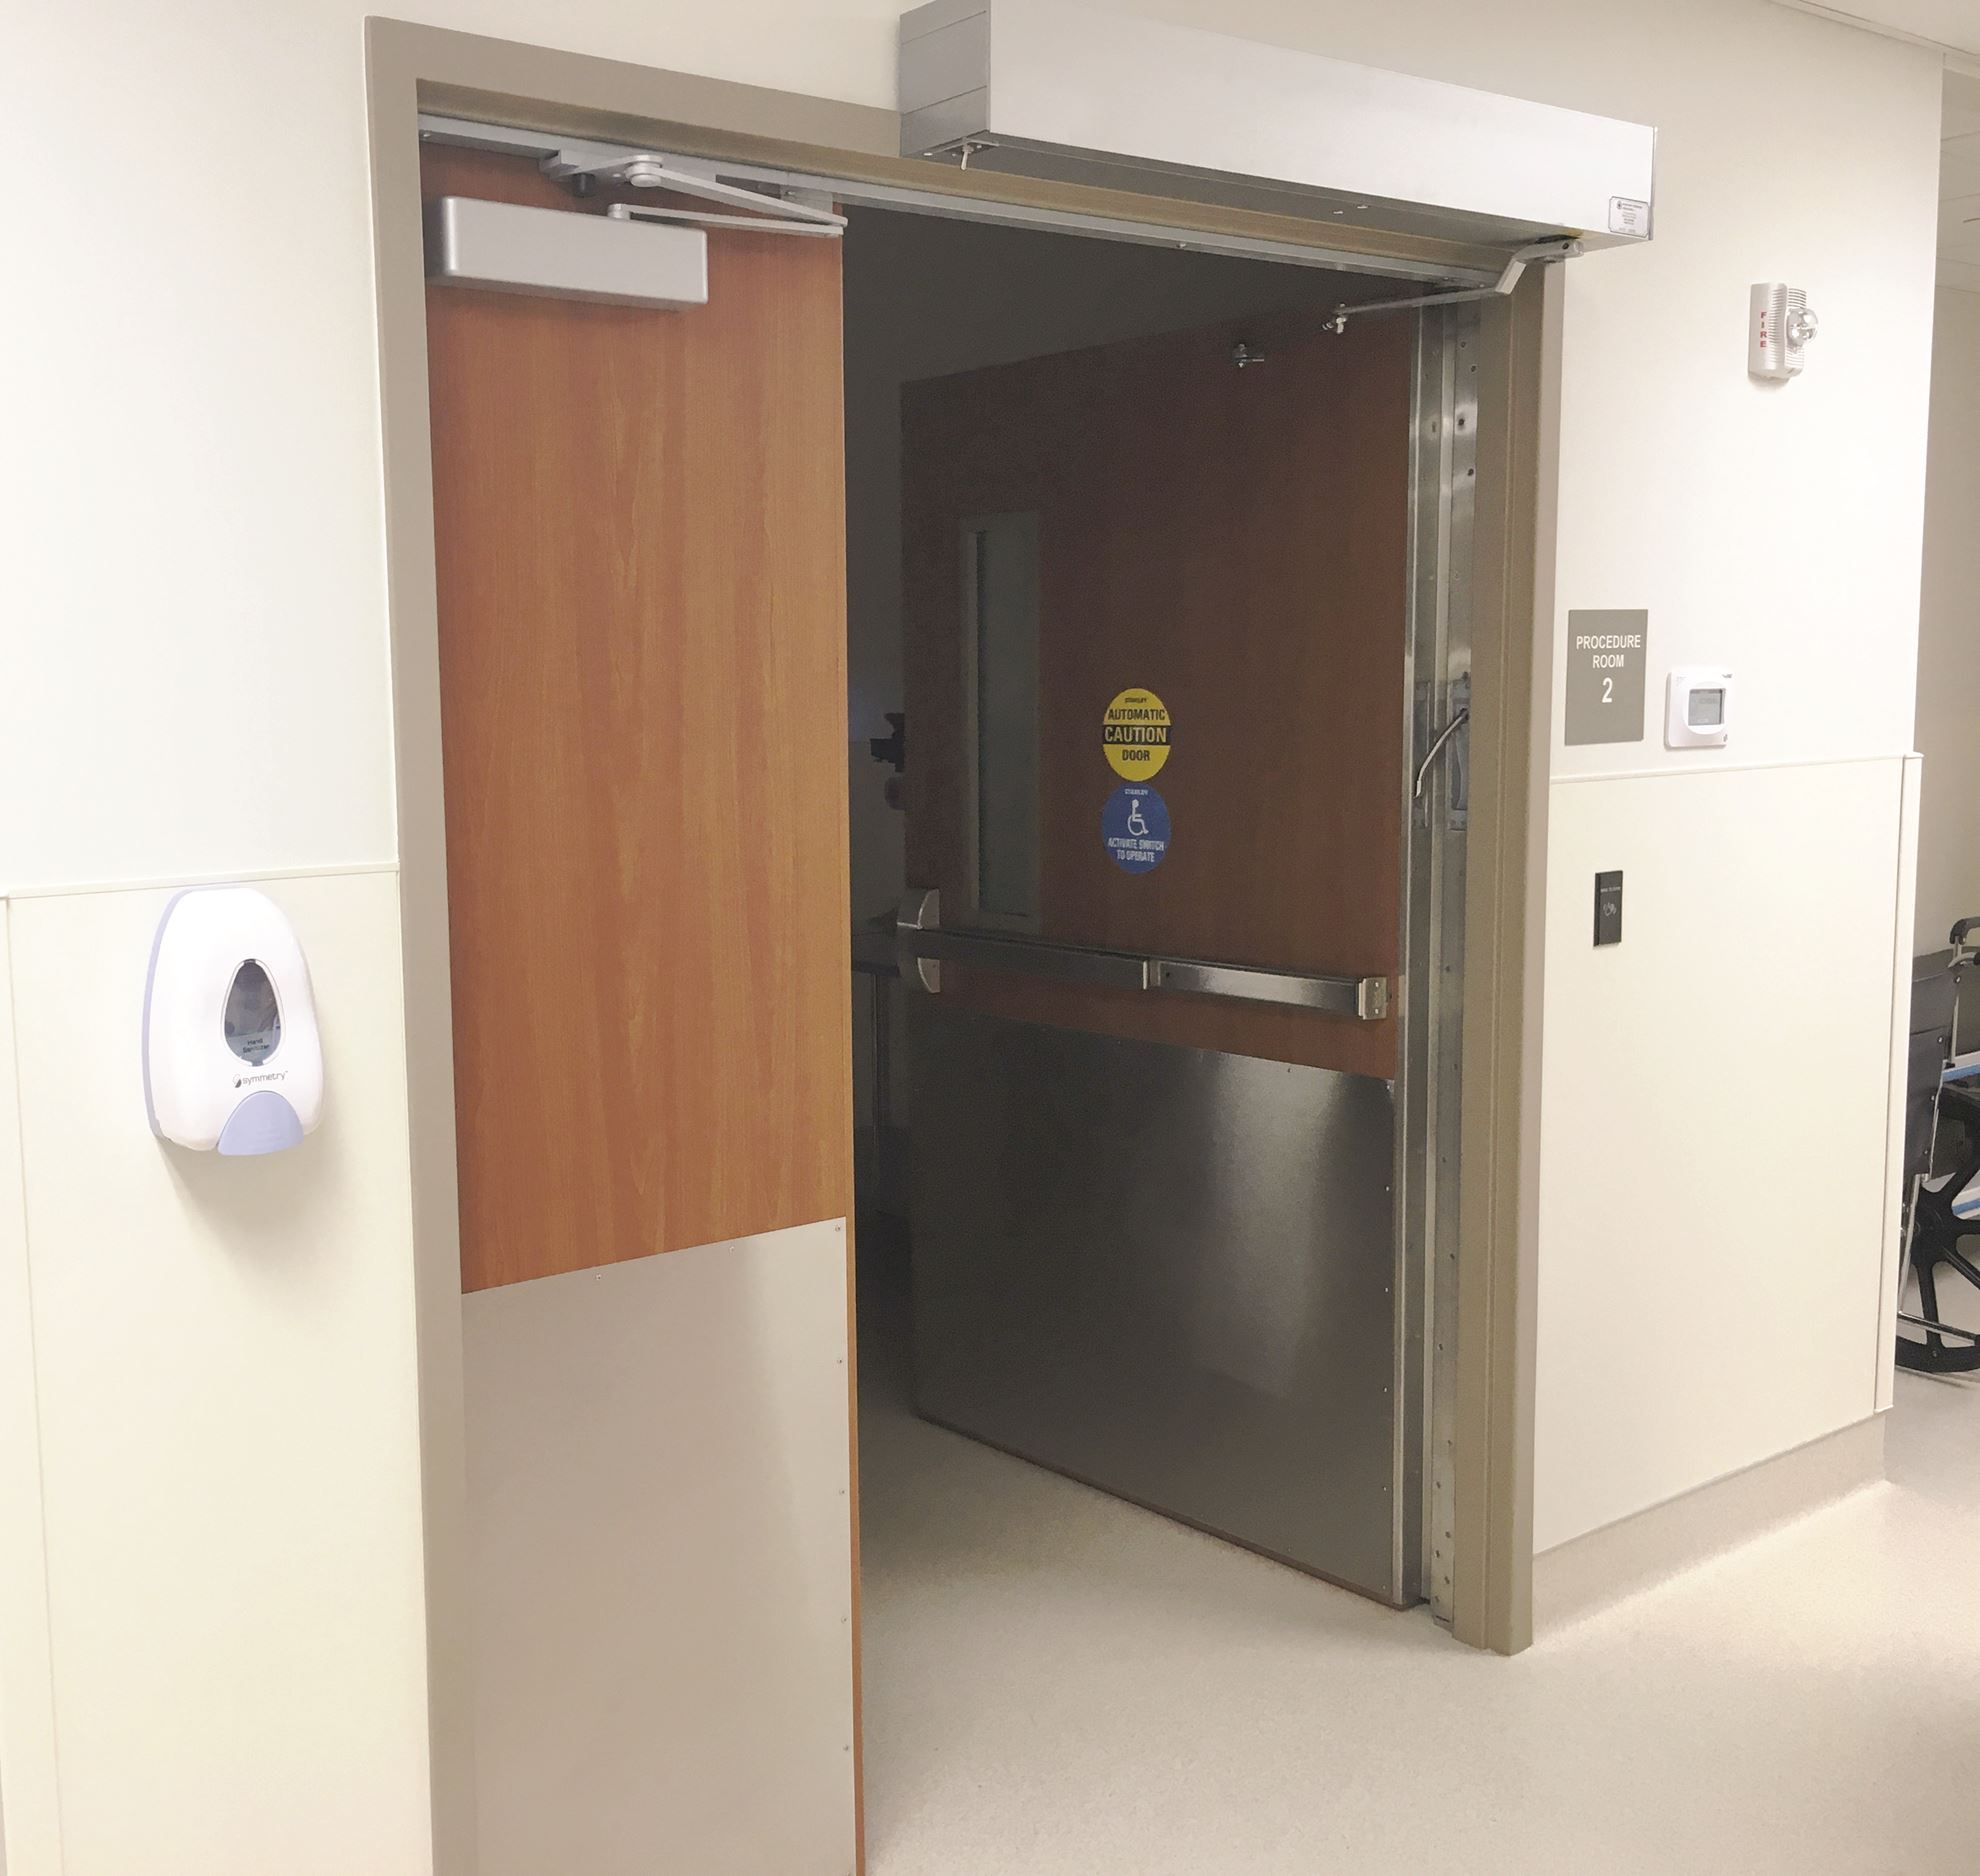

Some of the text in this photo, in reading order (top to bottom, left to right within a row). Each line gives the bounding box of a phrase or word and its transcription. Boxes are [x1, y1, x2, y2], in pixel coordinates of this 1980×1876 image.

[1576, 634, 1641, 650] PROCEDURE
[1592, 654, 1624, 669] ROOM
[1602, 677, 1613, 703] 2
[1108, 708, 1166, 721] AUTOMATIC
[1104, 726, 1167, 743] CAUTION
[1122, 749, 1150, 761] DOOR
[1107, 837, 1137, 849] ACTIVATE
[1117, 849, 1125, 860] TO
[242, 1072, 286, 1085] symmetry
